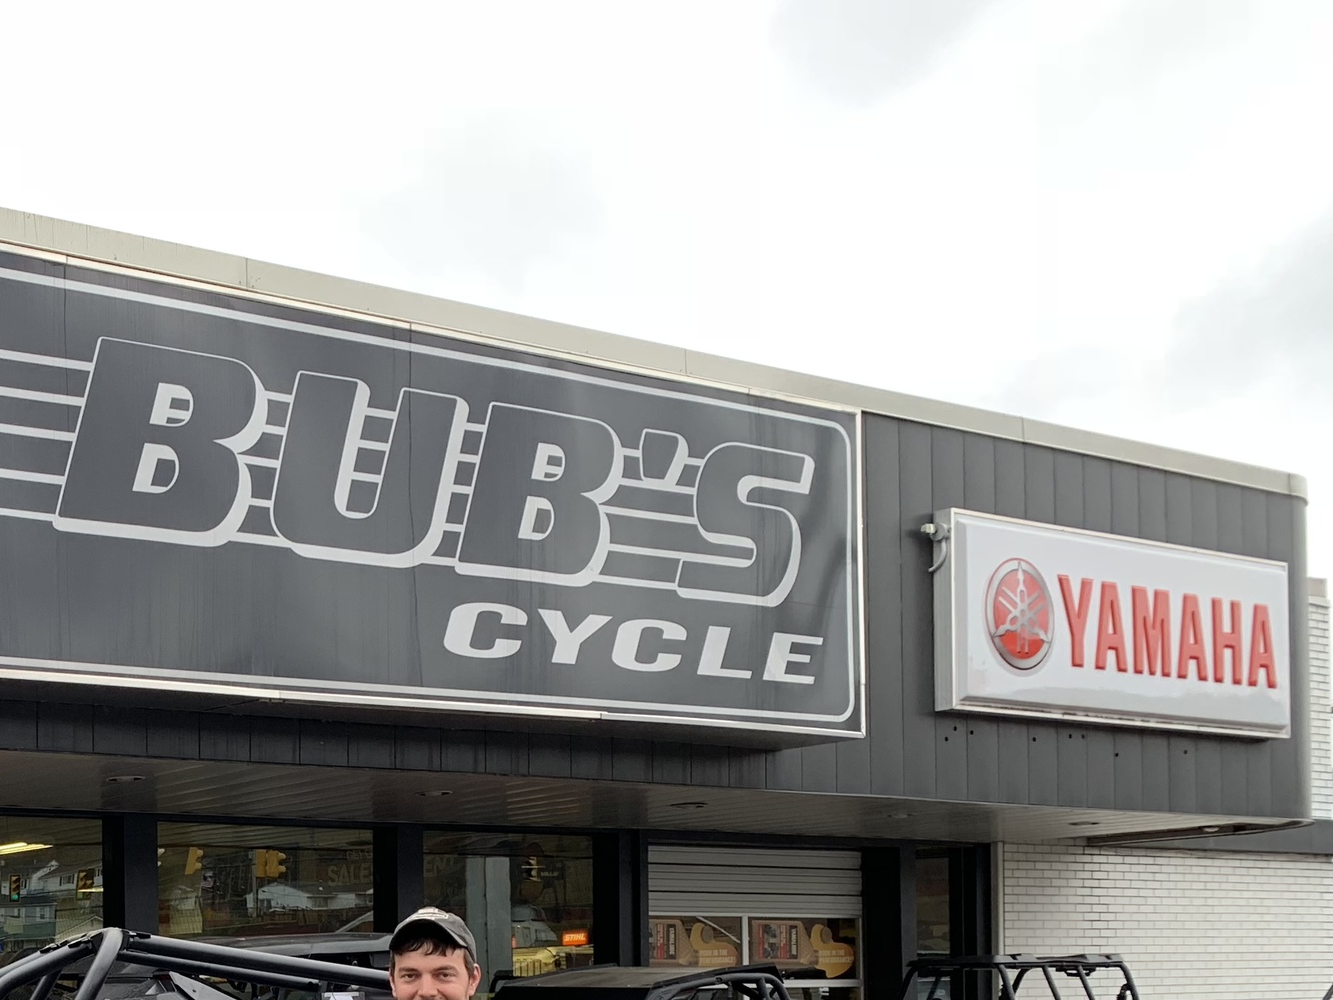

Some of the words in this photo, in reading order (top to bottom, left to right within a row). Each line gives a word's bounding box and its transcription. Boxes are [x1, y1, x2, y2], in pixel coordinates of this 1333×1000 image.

[52, 335, 816, 608] BUB'S
[443, 602, 825, 685] CYCLE
[1057, 574, 1278, 689] YAMAHA
[566, 932, 586, 942] STIHL
